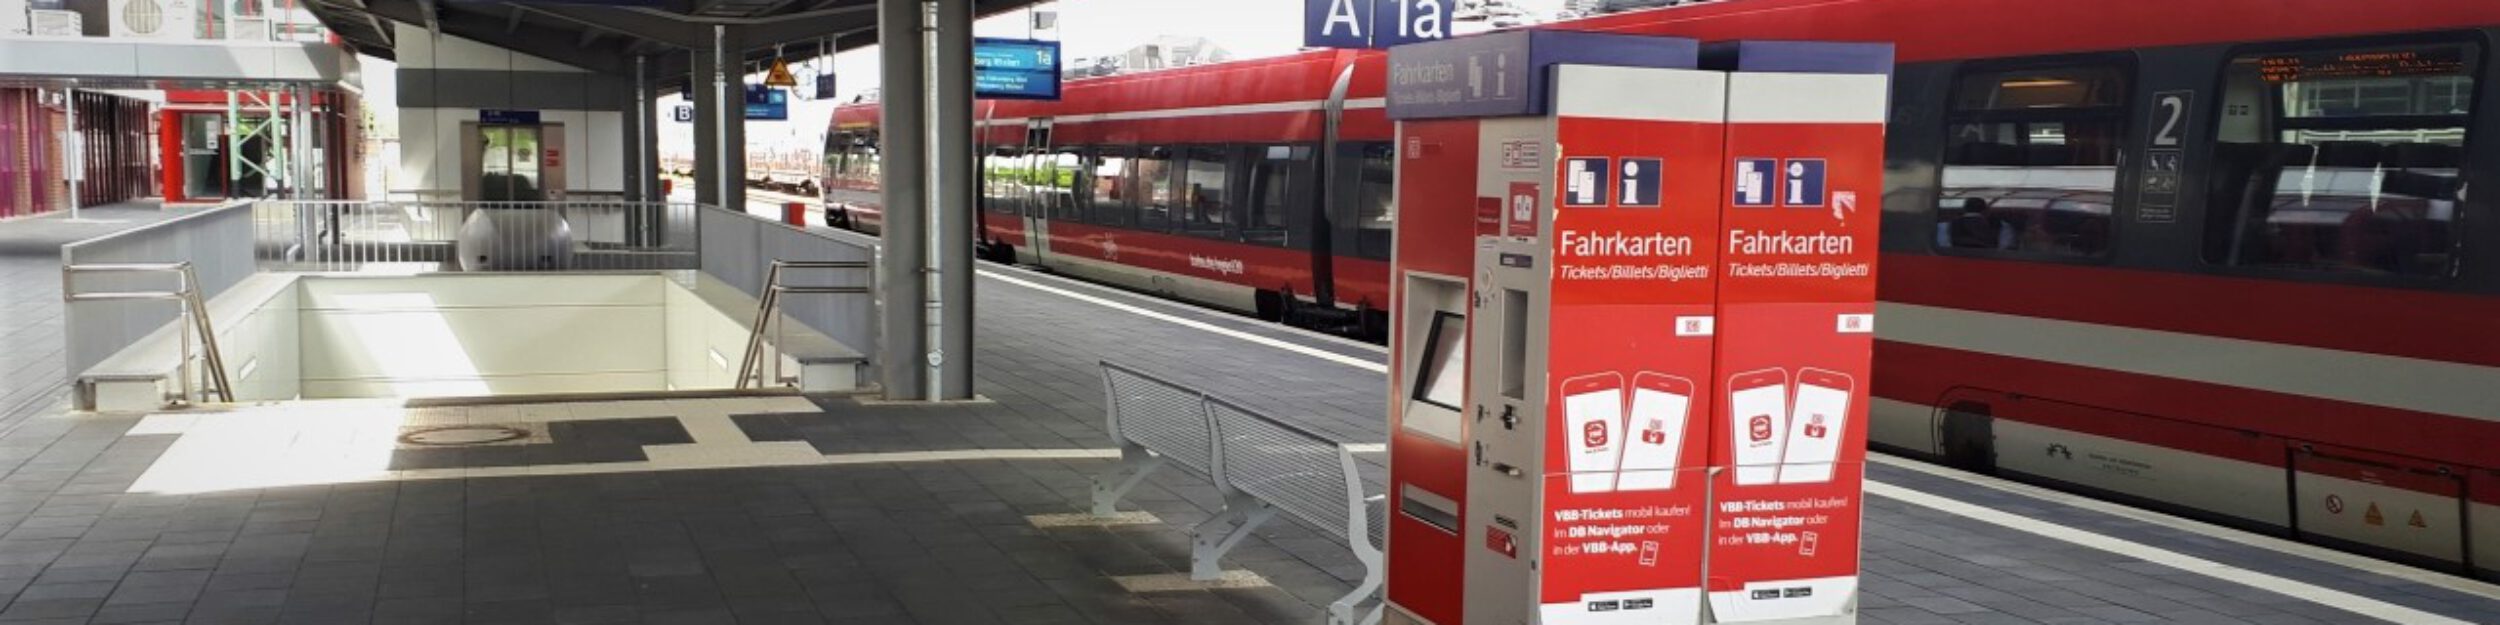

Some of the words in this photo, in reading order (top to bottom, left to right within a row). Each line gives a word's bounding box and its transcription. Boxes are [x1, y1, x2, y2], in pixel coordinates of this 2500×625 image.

[1322, 0, 1360, 37] A
[1398, 0, 1444, 39] 1a
[1036, 50, 1051, 65] 1a
[1393, 61, 1454, 85] Fahrkarten
[679, 106, 690, 120] B
[2154, 97, 2182, 145] 2
[1560, 231, 1691, 256] Fahrkarten
[1729, 230, 1852, 254] Fahrkarten
[1560, 264, 1708, 282] Tickets/Billets/Biglietti
[1729, 263, 1869, 280] Tickets/Billets/Biglietti
[1554, 508, 1623, 521] VBB-Tickets
[1625, 506, 1653, 518] mobil
[1655, 504, 1691, 516] kaufen!
[1720, 500, 1785, 512] VBB-Tickets
[1787, 498, 1812, 509] mobil
[1814, 497, 1848, 508] kaufen!
[1568, 526, 1586, 537] DB
[1588, 524, 1645, 537] Navigator
[1647, 522, 1670, 534] oder
[1734, 517, 1750, 528] DB
[1751, 515, 1804, 529] Navigator
[1806, 514, 1828, 524] oder
[1718, 535, 1727, 545] in
[1728, 534, 1744, 545] der
[1746, 532, 1799, 545] VBB-App.
[1553, 545, 1563, 555] in
[1564, 543, 1580, 555] der
[1582, 540, 1638, 555] VBB-App.
